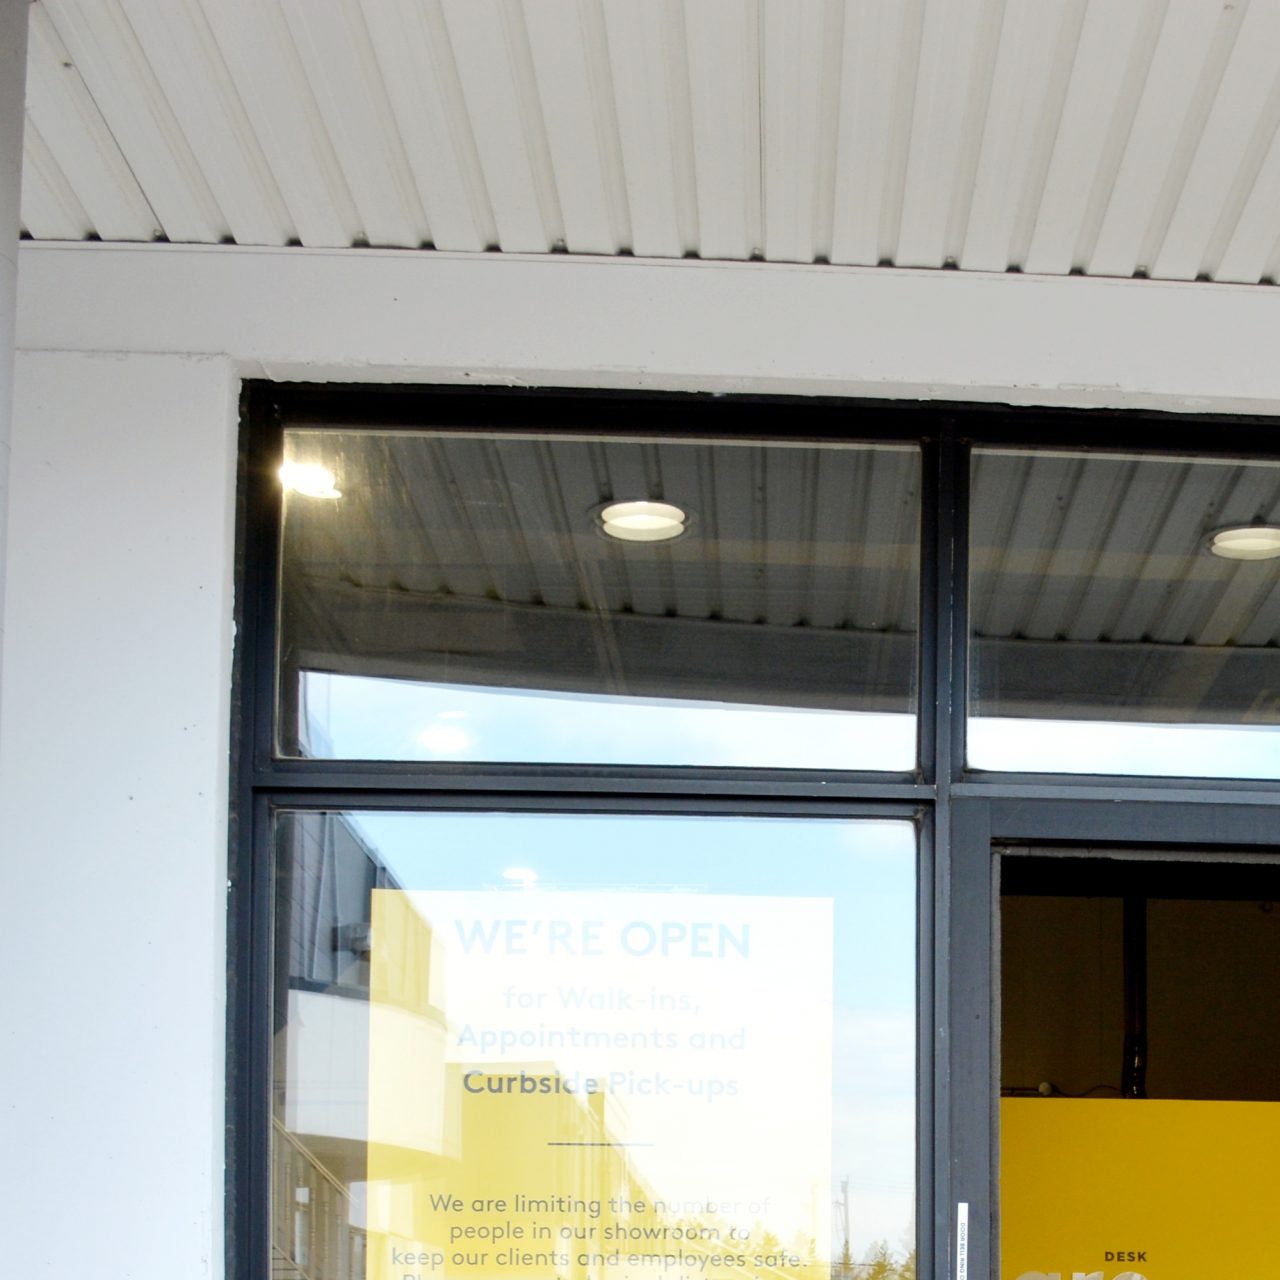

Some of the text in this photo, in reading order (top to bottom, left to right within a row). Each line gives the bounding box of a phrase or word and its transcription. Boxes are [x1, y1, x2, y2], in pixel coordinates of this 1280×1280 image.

[620, 921, 751, 958] OPEN
[502, 986, 700, 1015] for Walk-ins,
[456, 1023, 746, 1054] Appointments and
[463, 1070, 739, 1102] Curbside Pick-ups
[429, 1194, 771, 1218] We are limiting the number of
[450, 1222, 750, 1244] people in our showroom to
[392, 1248, 808, 1272] keep our clients and employees safe.
[1105, 1252, 1147, 1262] DESK
